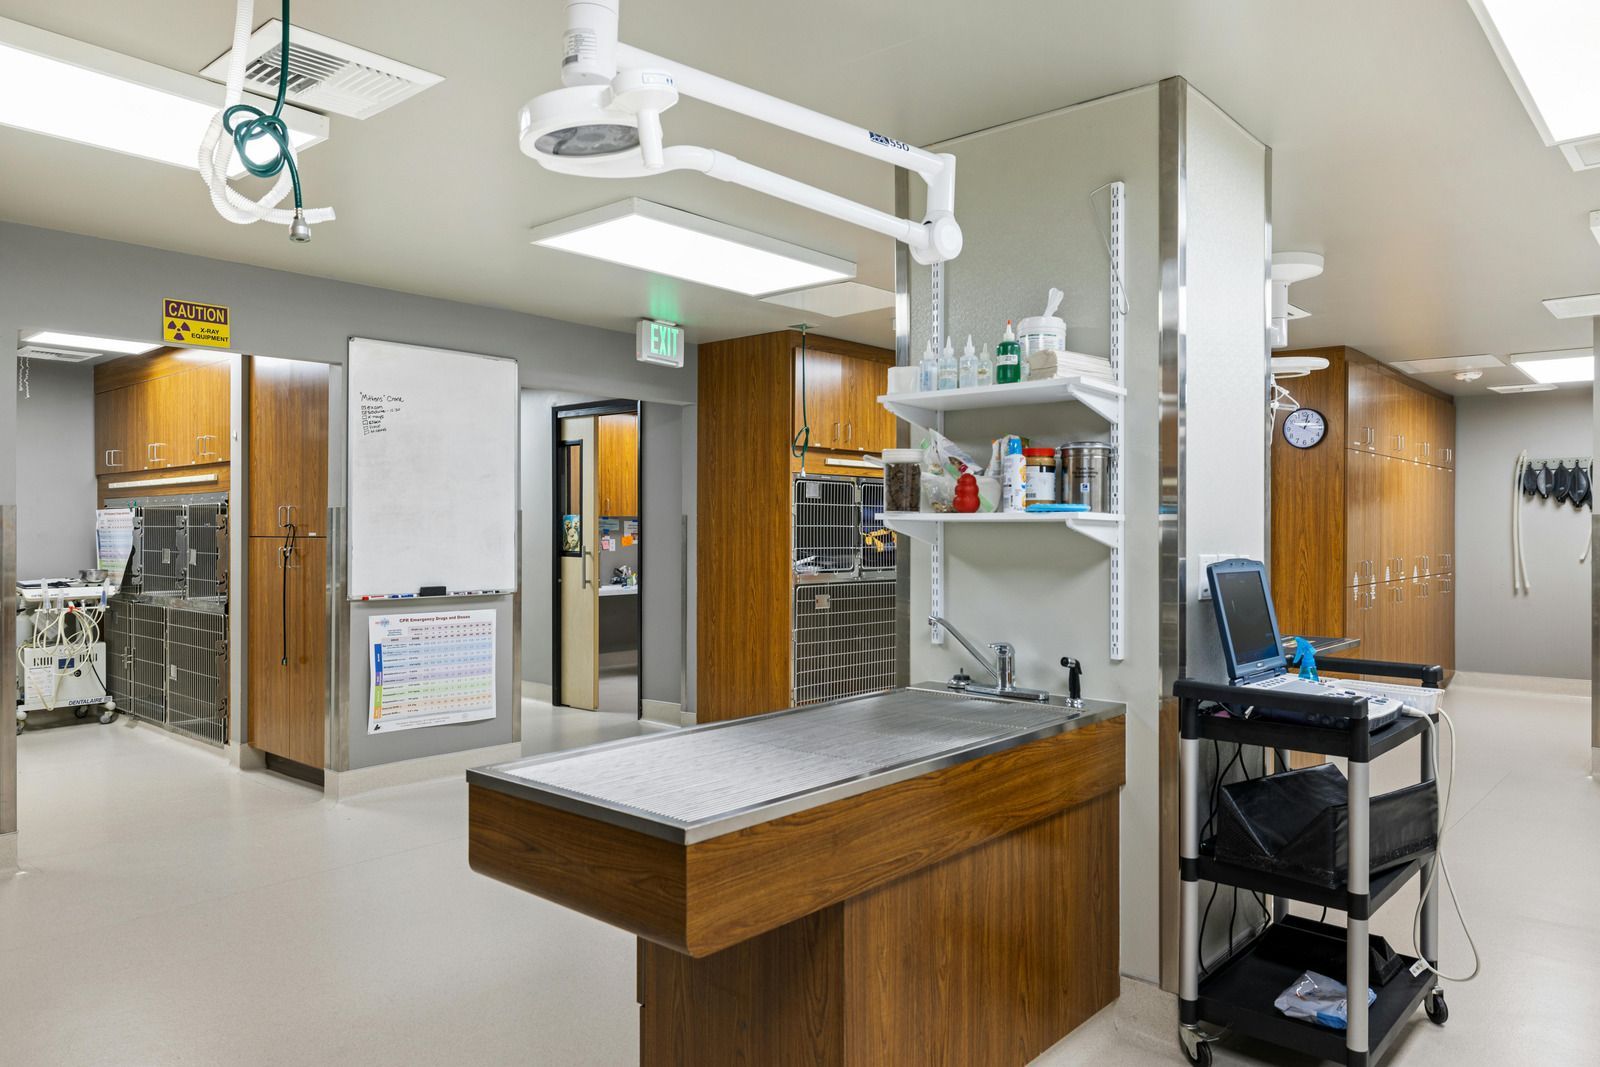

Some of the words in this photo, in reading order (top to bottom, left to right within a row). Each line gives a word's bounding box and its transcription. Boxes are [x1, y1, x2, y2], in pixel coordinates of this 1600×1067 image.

[168, 302, 225, 323] CAUTION
[191, 333, 229, 342] EQUIPMENT
[200, 327, 220, 335] X-RAY
[650, 323, 678, 359] EXIT
